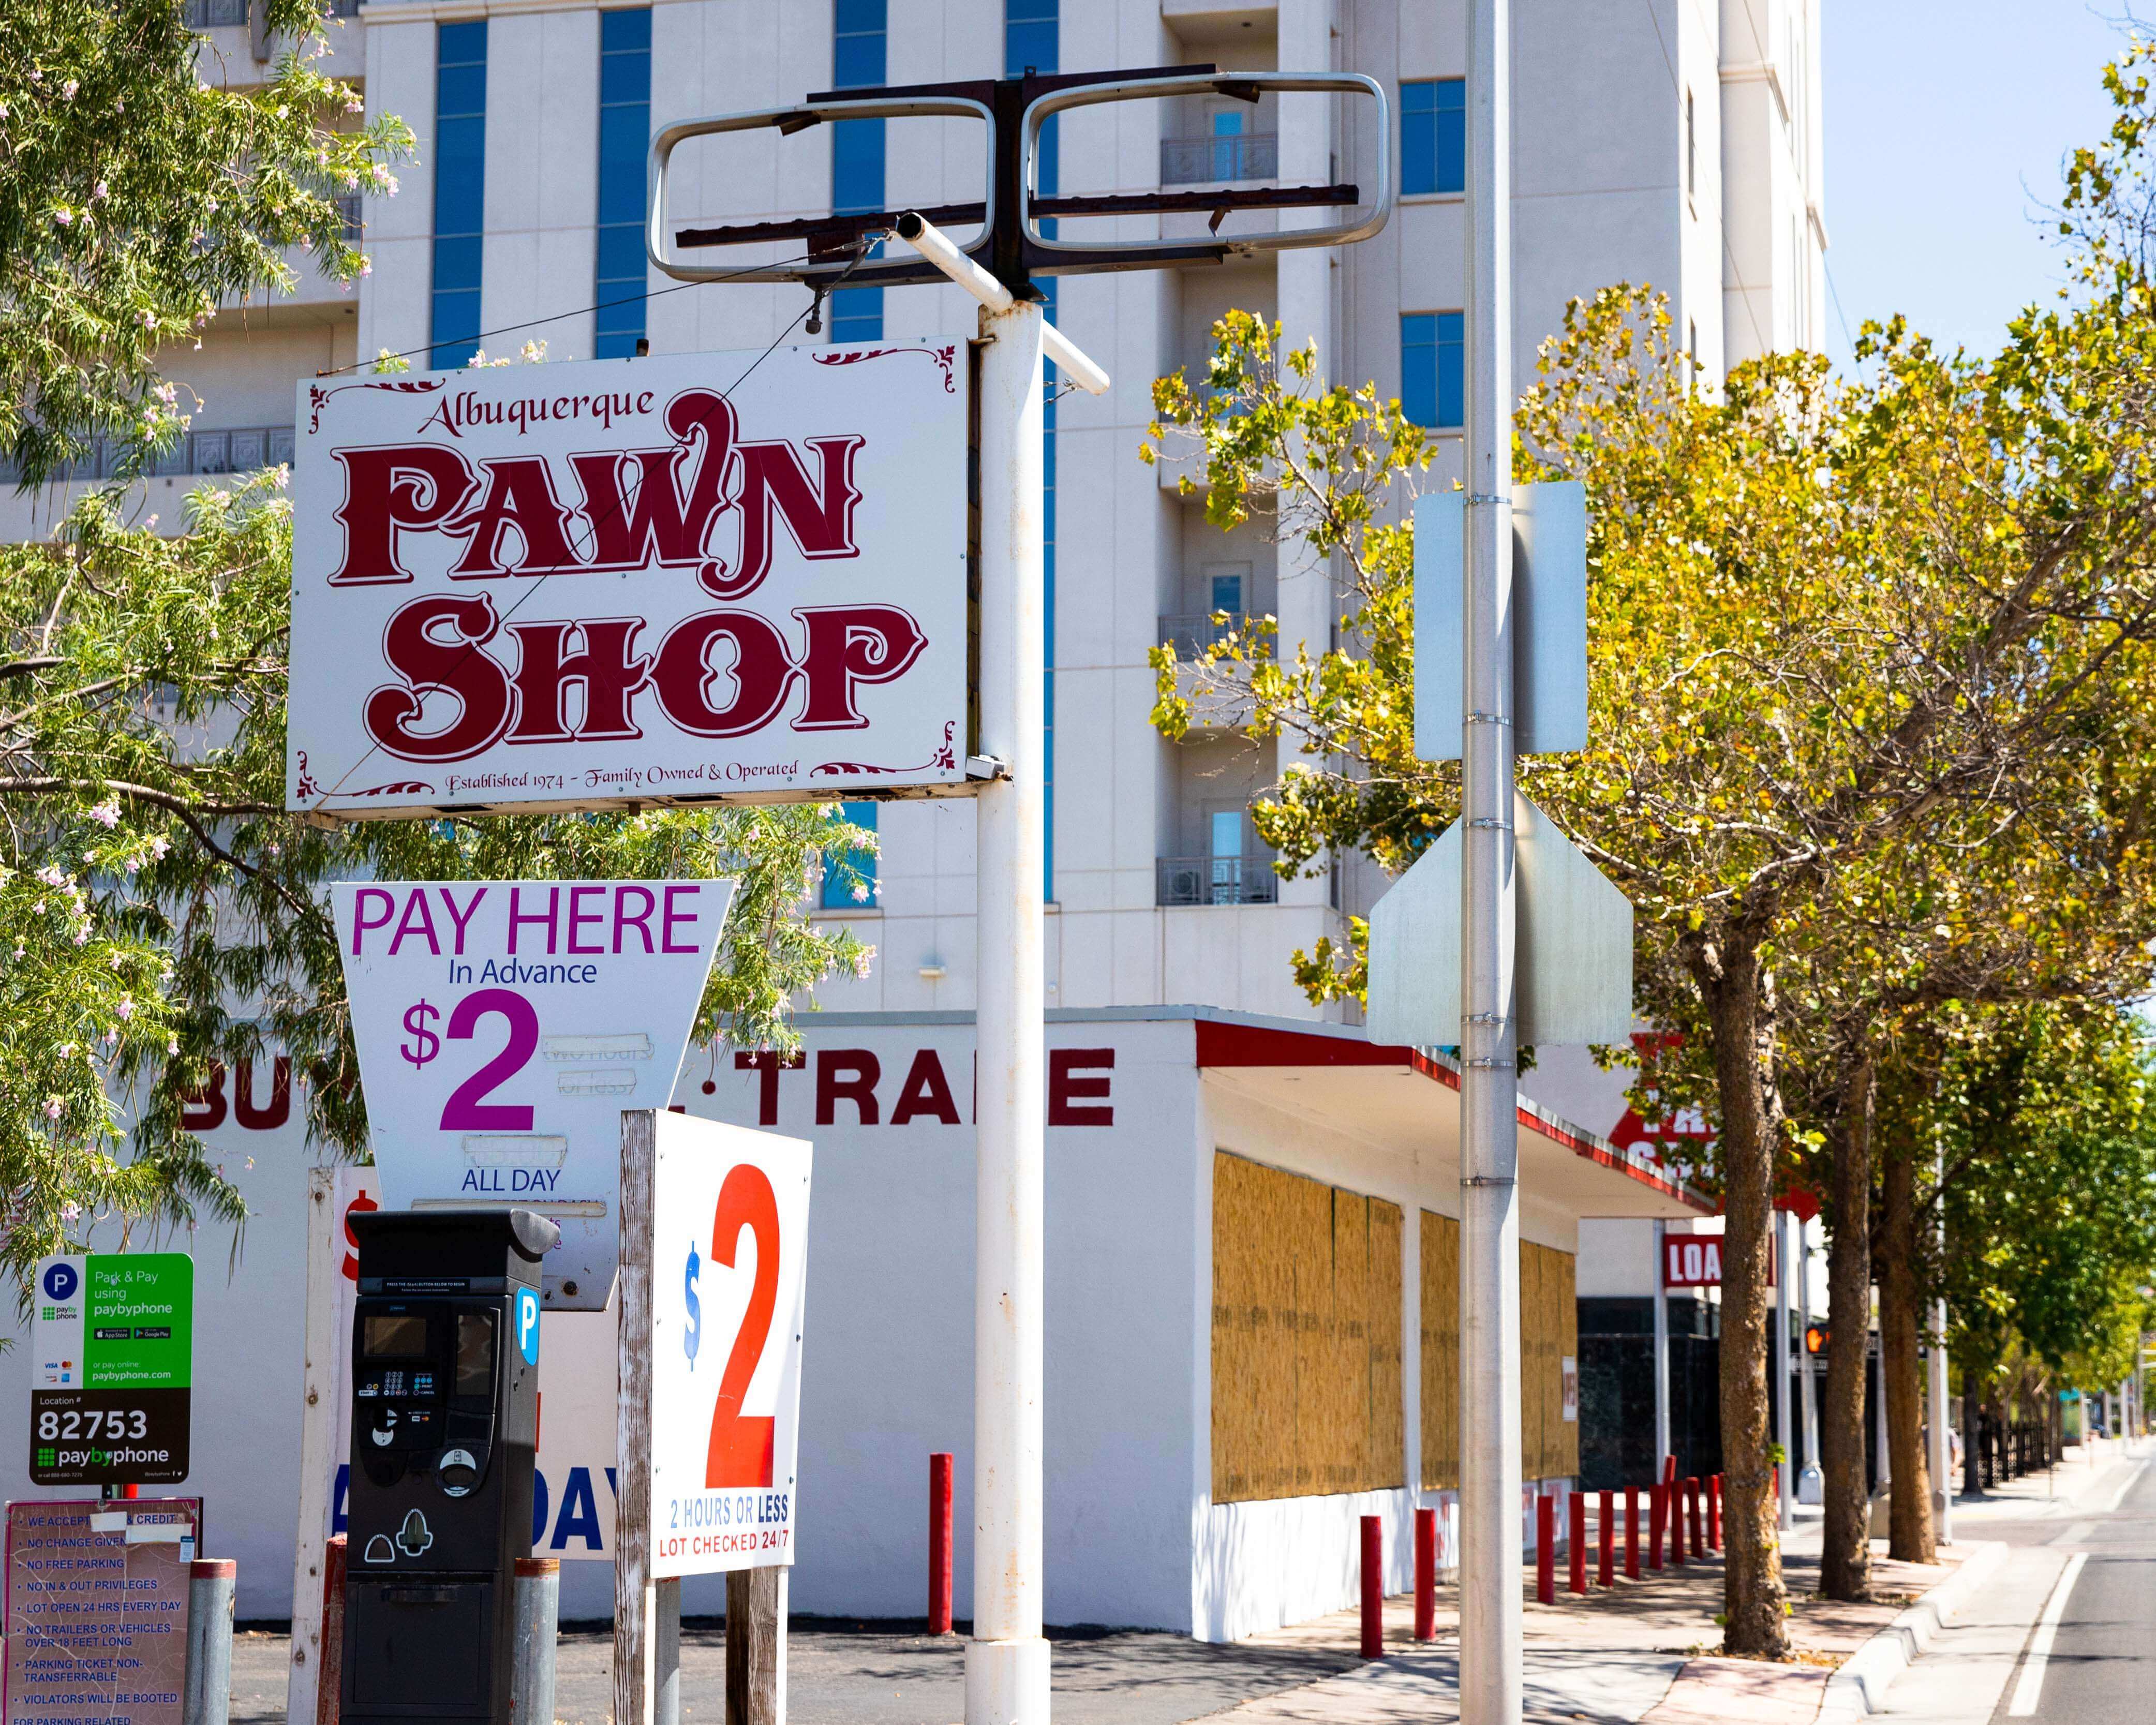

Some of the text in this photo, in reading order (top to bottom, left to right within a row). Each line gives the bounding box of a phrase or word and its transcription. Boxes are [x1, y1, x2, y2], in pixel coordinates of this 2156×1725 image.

[418, 390, 655, 439] Albuquerque
[328, 387, 866, 601] PAWN
[363, 591, 928, 763] SHOP
[445, 772, 528, 791] Established
[533, 775, 563, 790] 1974
[584, 768, 642, 788] Family
[647, 765, 704, 784] Owned
[708, 764, 721, 779] &
[726, 760, 798, 780] Operated
[352, 885, 700, 956] PAY HERE
[449, 958, 598, 984] In Advance
[400, 988, 539, 1131] $2
[735, 1048, 1115, 1126] TRAE
[462, 1169, 561, 1191] ALL DAY
[1669, 1244, 1722, 1282] LOA
[54, 1274, 68, 1292] P
[95, 1271, 158, 1285] Park & Pay
[95, 1287, 126, 1301] using
[56, 1305, 77, 1314] payby
[94, 1302, 172, 1317] paybyphone
[521, 1295, 537, 1350] P
[684, 1164, 780, 1489] $2
[93, 1371, 171, 1381] paybyphone.com
[38, 1410, 147, 1440] 82753
[58, 1447, 169, 1467] paybyphone
[28, 1514, 175, 1526] WE ACCEPT & CREDIT
[671, 1494, 787, 1528] 2 HOURS OR LESS
[27, 1539, 43, 1548] NO
[46, 1538, 93, 1548] CHANGE
[660, 1529, 789, 1557] LOT CHECKED 24/7
[27, 1559, 124, 1570] NO FREE PARKING
[26, 1580, 157, 1592] NO IN & OUT PRIVILEGES
[26, 1601, 182, 1613] LOT OPEN 24 HRS EVERY DAY
[26, 1624, 171, 1635] NO TRAILERS OR VEHICLES
[25, 1637, 132, 1648] OVER 18 FEET LONG
[25, 1659, 143, 1670] PARKING TICKET NON-
[24, 1672, 117, 1682] TRANSFERRABLE
[24, 1693, 177, 1704] VIOLATORS WILL BE BOOTED
